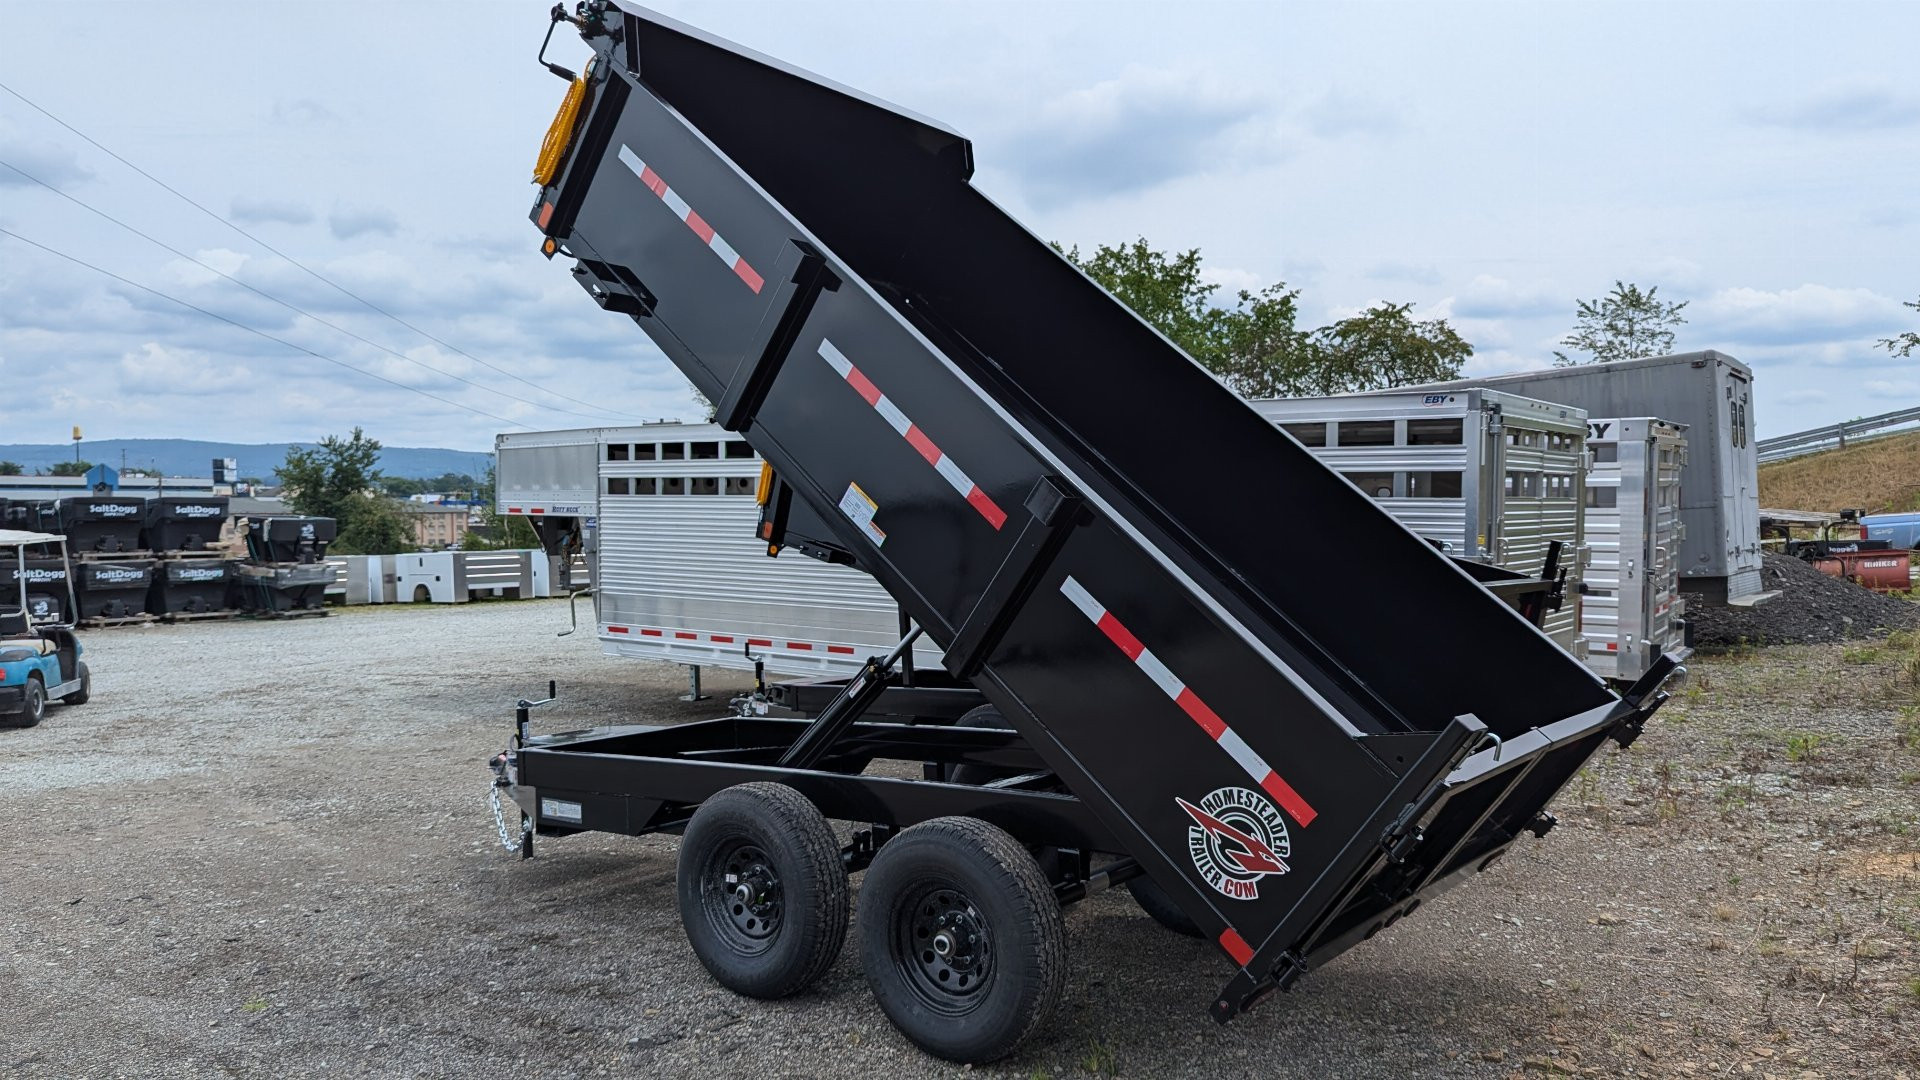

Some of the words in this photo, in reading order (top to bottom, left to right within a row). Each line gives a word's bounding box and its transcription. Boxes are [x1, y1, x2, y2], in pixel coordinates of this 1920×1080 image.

[1424, 395, 1448, 404] EBY
[90, 504, 137, 514] SaltDogg
[176, 505, 220, 515] SaltDogg
[96, 570, 143, 579] SaltDogg
[180, 568, 224, 578] SaltDogg
[1203, 788, 1289, 857] HOMESTEADER
[1190, 827, 1257, 898] TRAILER.COM
